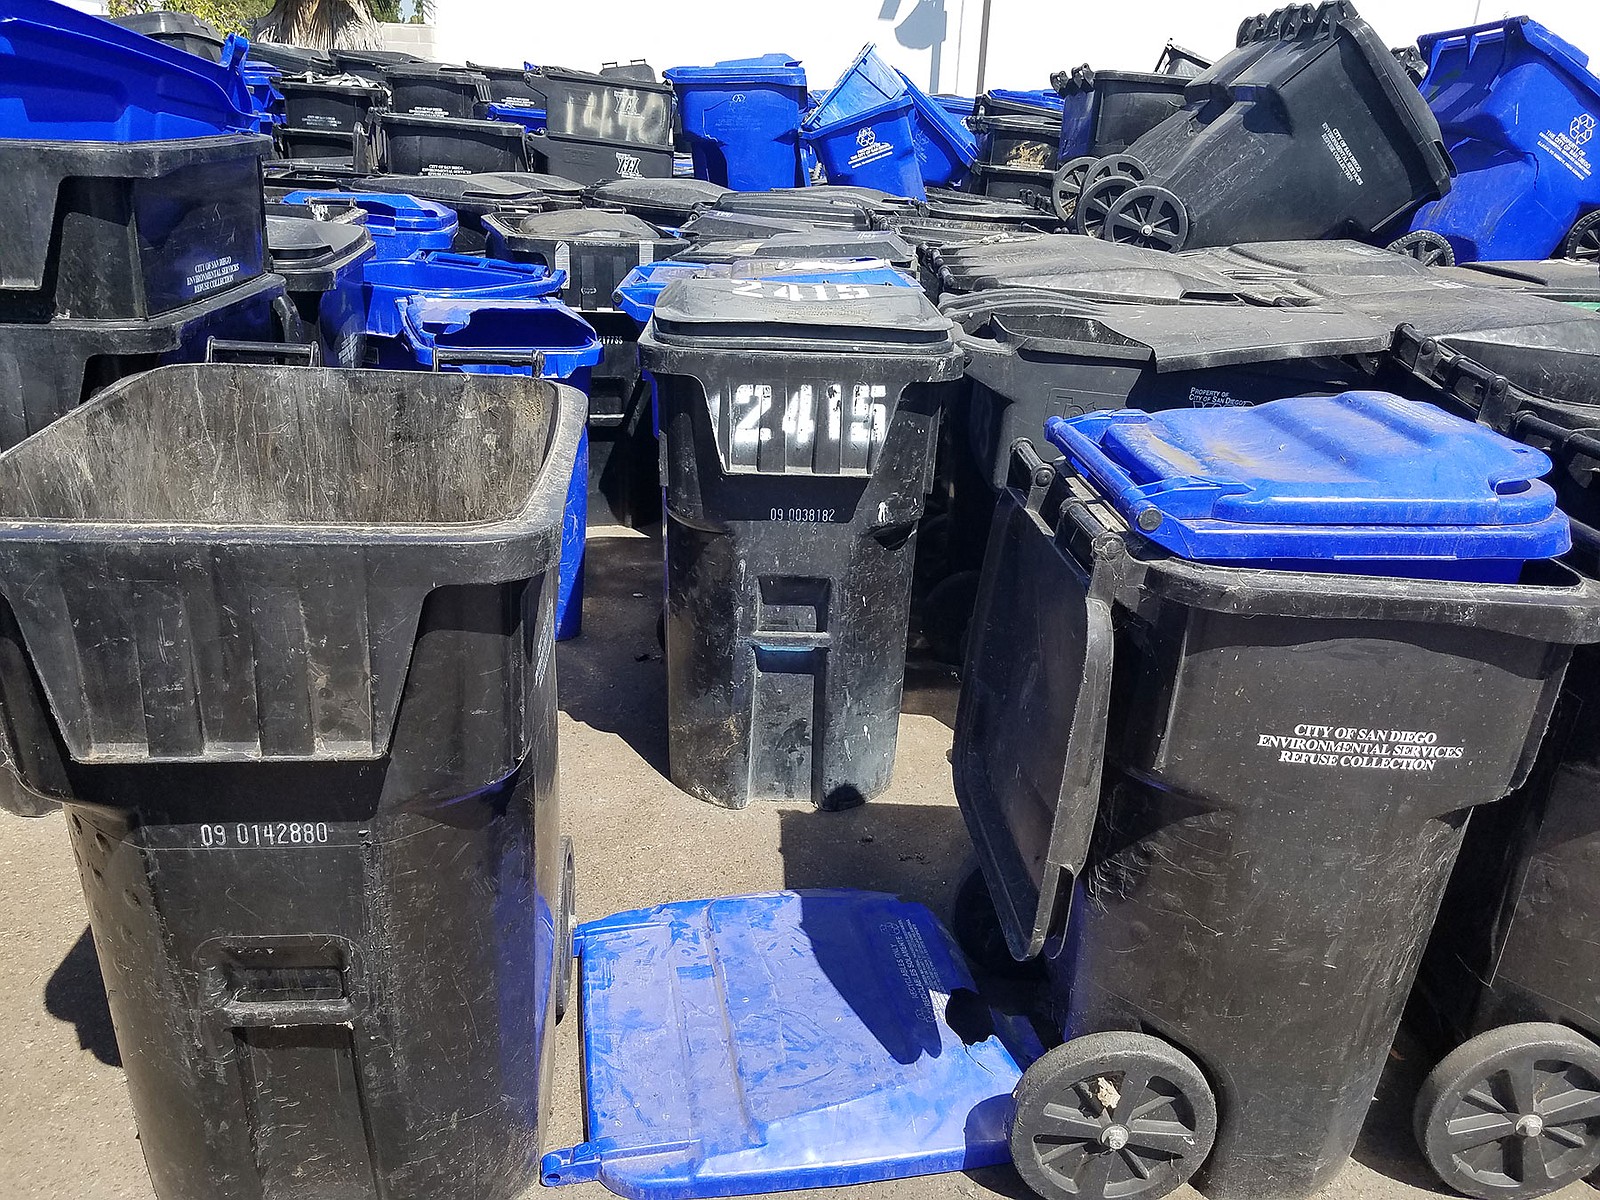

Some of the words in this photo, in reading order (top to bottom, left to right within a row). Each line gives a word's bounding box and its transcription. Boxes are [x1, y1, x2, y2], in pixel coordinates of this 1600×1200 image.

[731, 279, 869, 301] 2415
[734, 383, 887, 442] 2415
[770, 508, 784, 521] 09
[788, 508, 836, 522] 0038182
[1294, 723, 1333, 738] CITY
[1334, 727, 1358, 740] OF
[1357, 728, 1389, 742] SAN
[1389, 730, 1437, 744] DIEGO
[1257, 734, 1391, 756] ENVIRONMENTAL
[1391, 744, 1464, 759] SERVICES
[1279, 750, 1339, 767] REFUSE
[1340, 756, 1436, 771] COLLECTION
[200, 824, 227, 846] 09
[236, 822, 328, 845] 0142880
